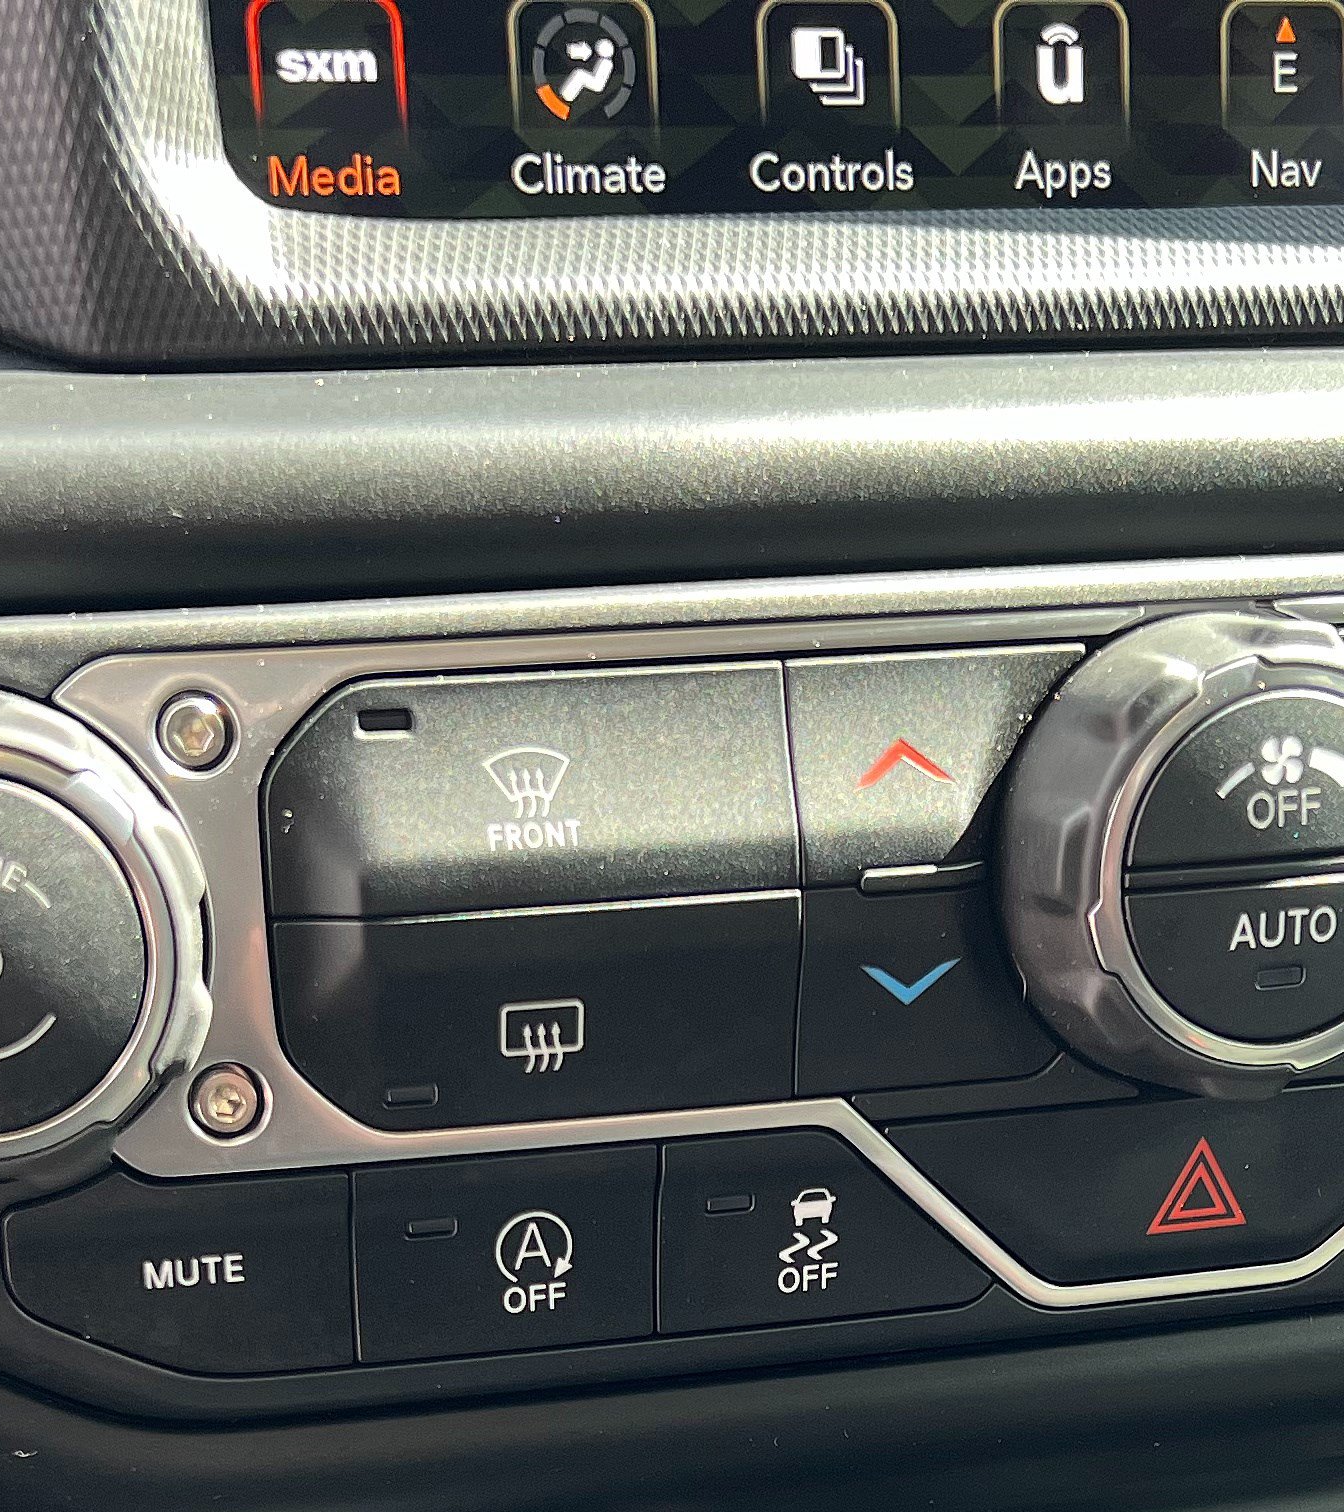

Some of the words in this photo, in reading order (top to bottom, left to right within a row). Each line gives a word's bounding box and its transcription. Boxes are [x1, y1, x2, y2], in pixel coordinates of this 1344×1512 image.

[276, 46, 378, 84] sxm
[1272, 52, 1299, 94] E
[267, 154, 402, 198] Media
[511, 152, 667, 195] Climate
[749, 150, 914, 193] Controls
[1015, 150, 1112, 198] Apps
[1250, 150, 1323, 189] Nav
[1246, 787, 1323, 831] OFF
[487, 817, 582, 853] FRONT
[1228, 905, 1339, 953] AUTO
[143, 1253, 246, 1292] MUTE
[776, 1261, 839, 1296] OFF
[502, 1280, 568, 1315] OFF
